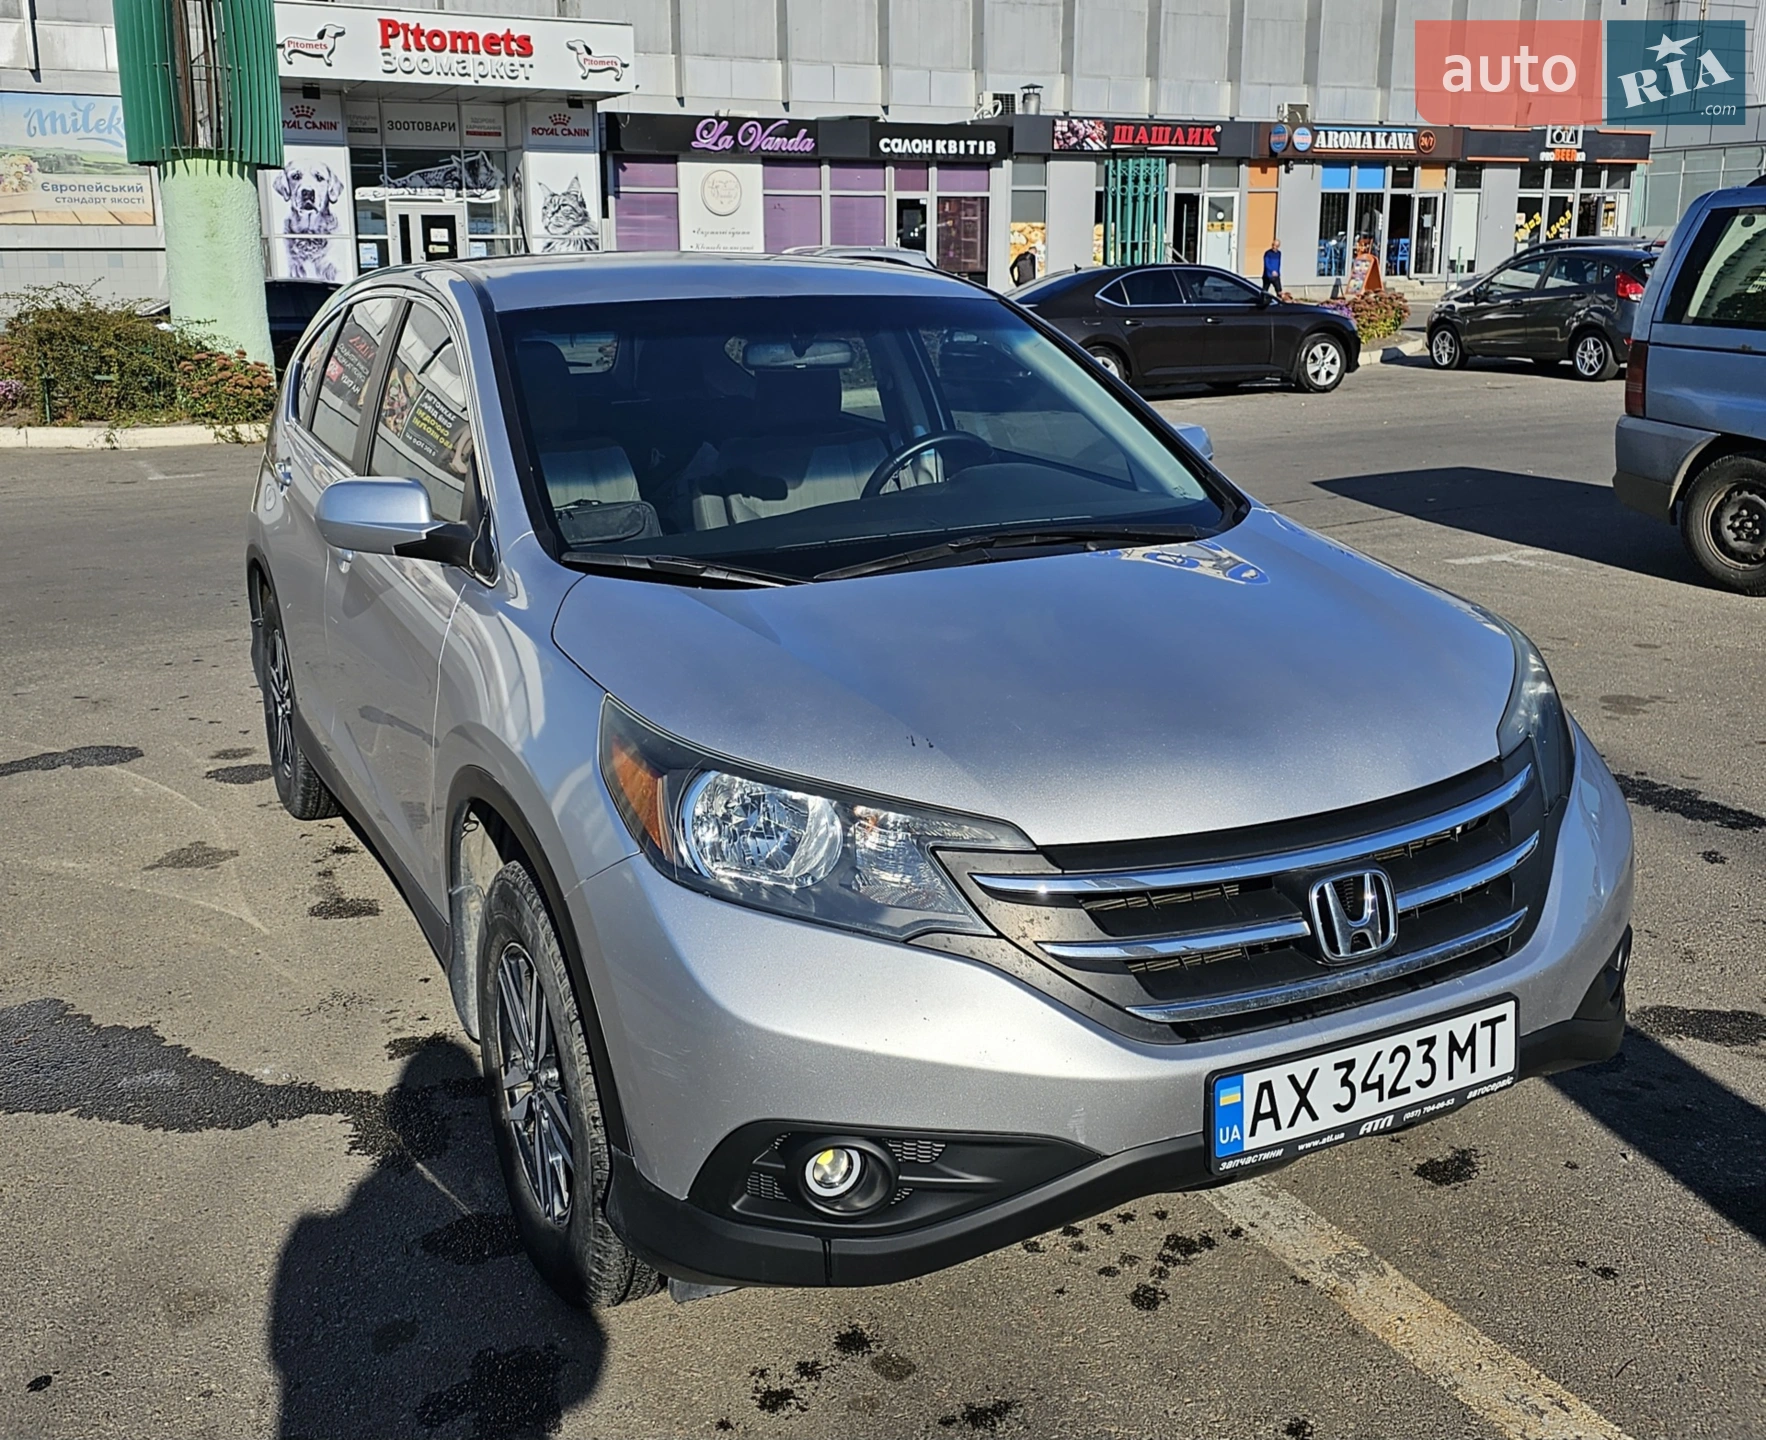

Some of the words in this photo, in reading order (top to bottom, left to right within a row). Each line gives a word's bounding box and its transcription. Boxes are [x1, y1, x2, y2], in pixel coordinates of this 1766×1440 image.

[378, 18, 534, 58] Pitomets
[282, 119, 303, 130] YAL
[304, 120, 338, 131] CANIN
[387, 120, 456, 132] ЗООТОВАРИ
[531, 127, 560, 137] ROYAL
[560, 128, 590, 138] CANIN
[691, 118, 735, 151] La
[737, 119, 816, 152] Vanda
[1112, 124, 1217, 146] ШАШЛИК
[1314, 130, 1372, 150] AROMA
[1374, 132, 1415, 150] KAVA
[41, 182, 144, 194] Європейський
[55, 195, 107, 205] стандарт
[110, 196, 145, 205] якості
[1248, 1067, 1320, 1138] AX
[1332, 1034, 1437, 1114] 3423
[1448, 1013, 1507, 1081] MT
[1219, 1124, 1241, 1144] UA
